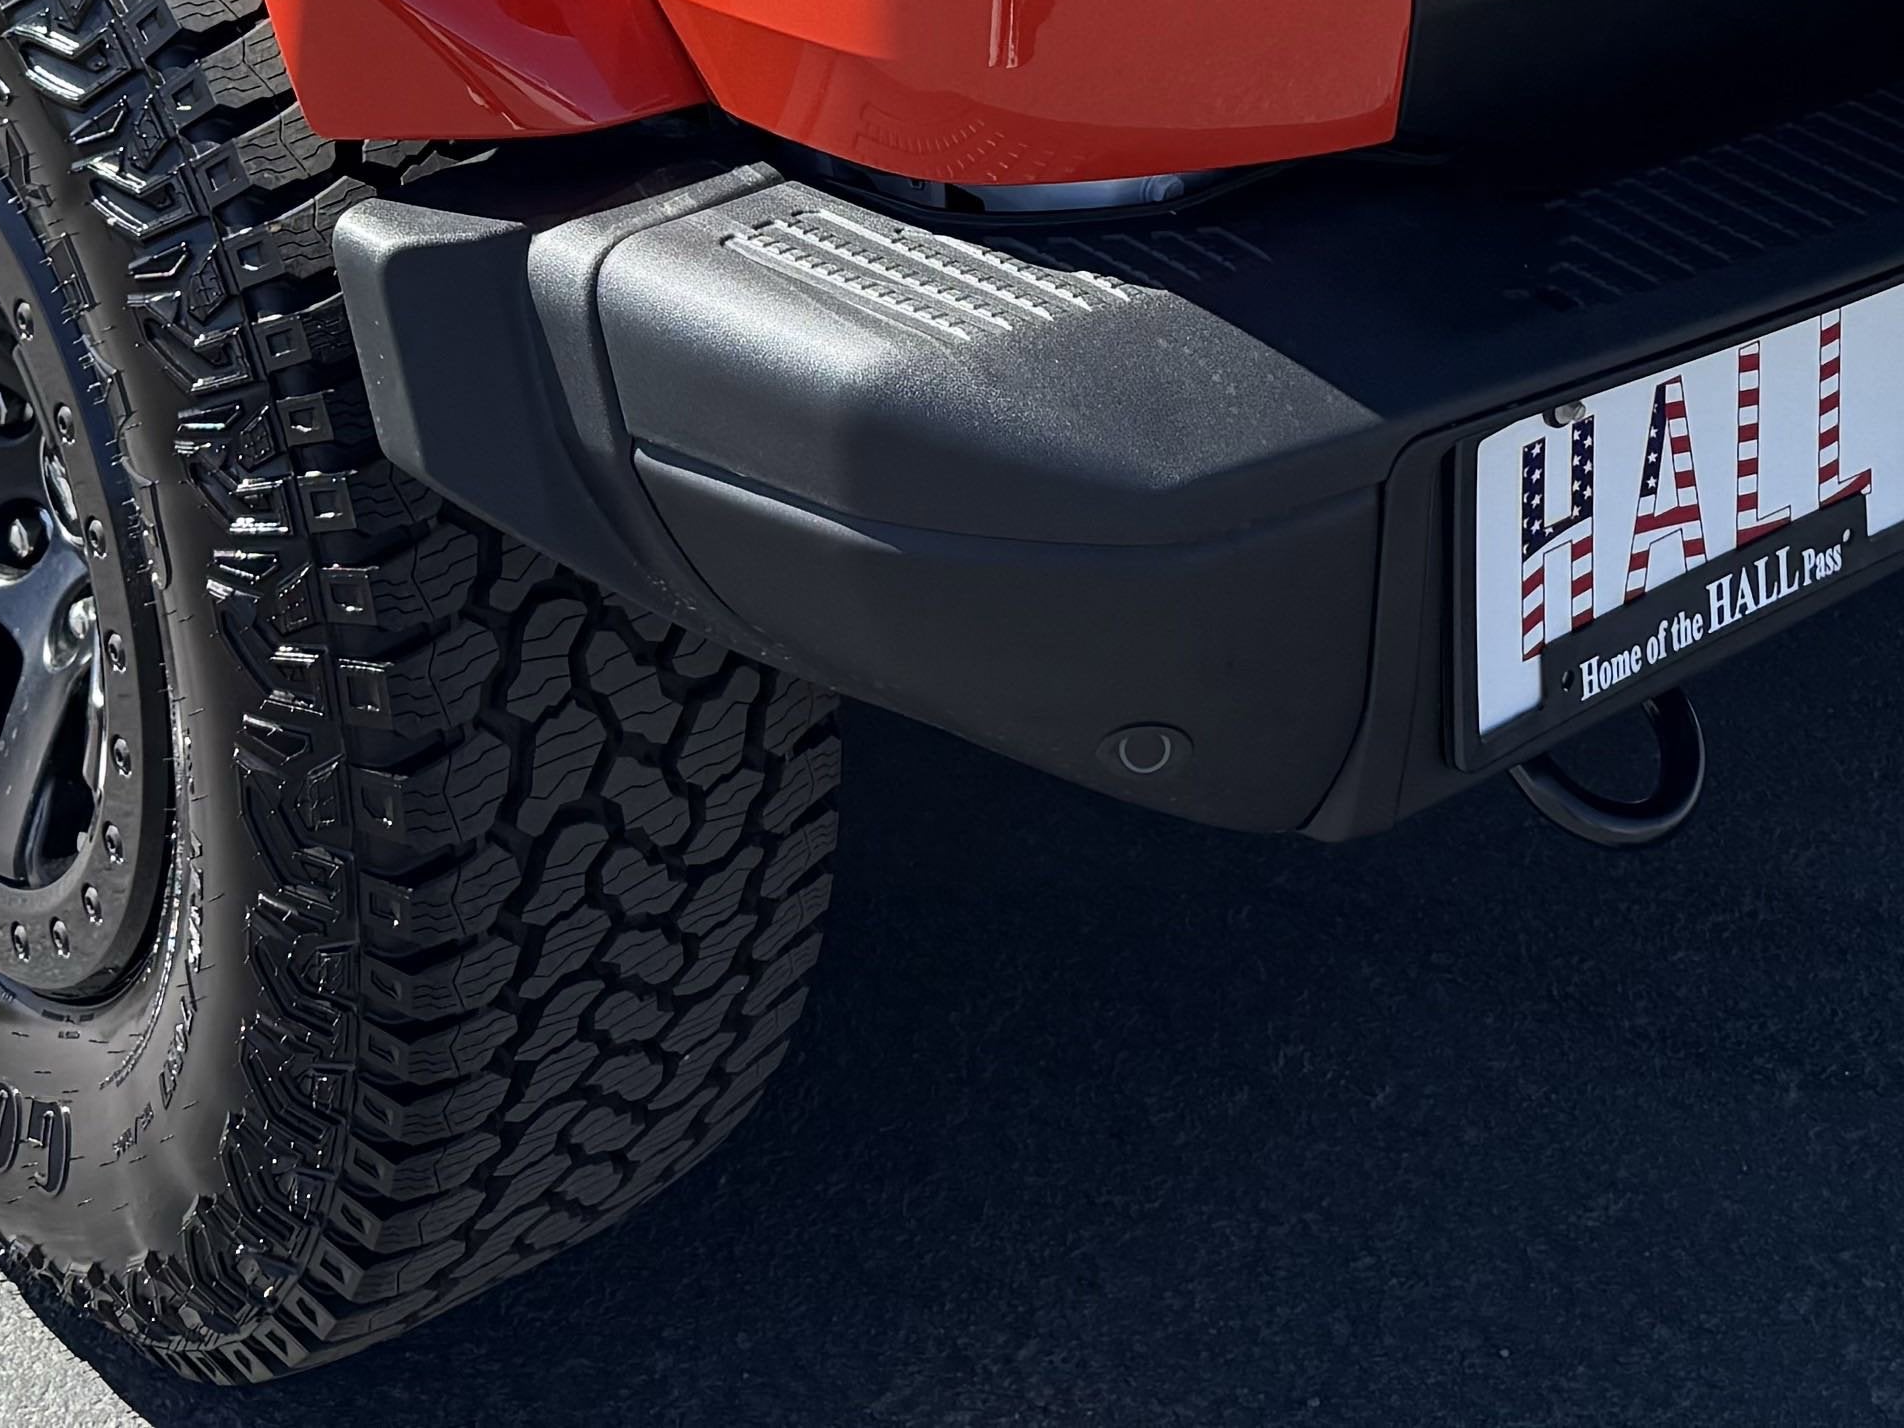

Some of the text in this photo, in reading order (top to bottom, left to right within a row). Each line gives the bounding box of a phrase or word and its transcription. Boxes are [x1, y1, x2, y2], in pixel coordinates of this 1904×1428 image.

[1521, 308, 1872, 661] HALL
[1579, 543, 1843, 703] Home of the HALL Pass
